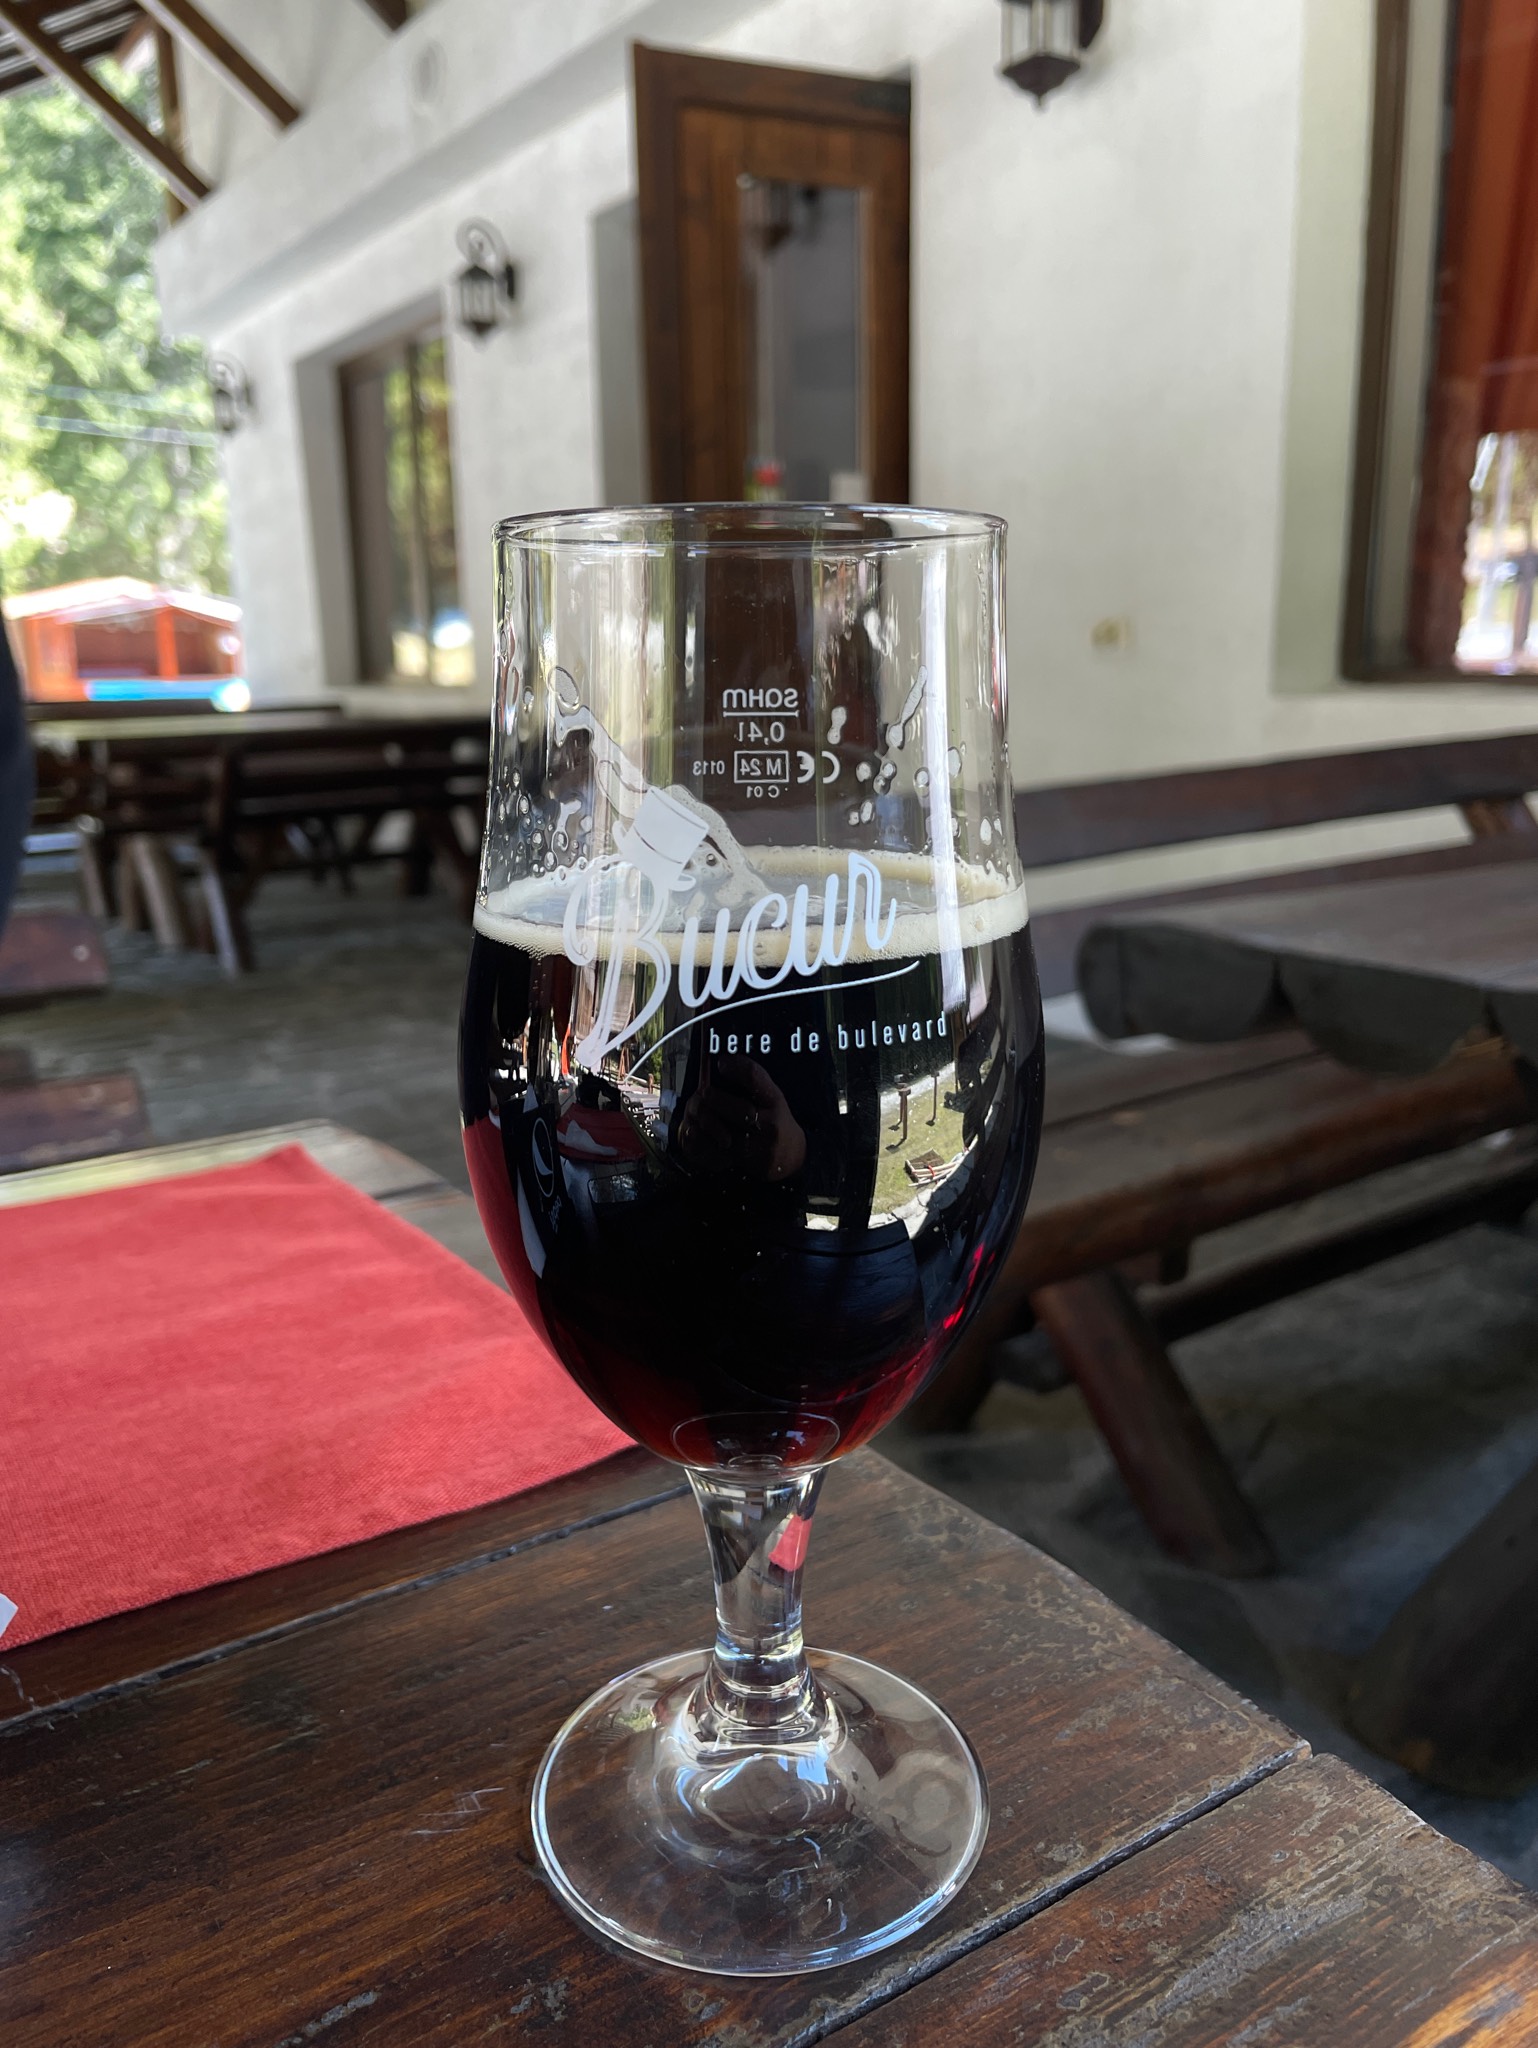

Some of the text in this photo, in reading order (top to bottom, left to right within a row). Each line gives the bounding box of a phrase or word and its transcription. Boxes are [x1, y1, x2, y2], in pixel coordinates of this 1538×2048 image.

[562, 851, 898, 1068] Bucur
[709, 1010, 948, 1054] bere de bulevard
